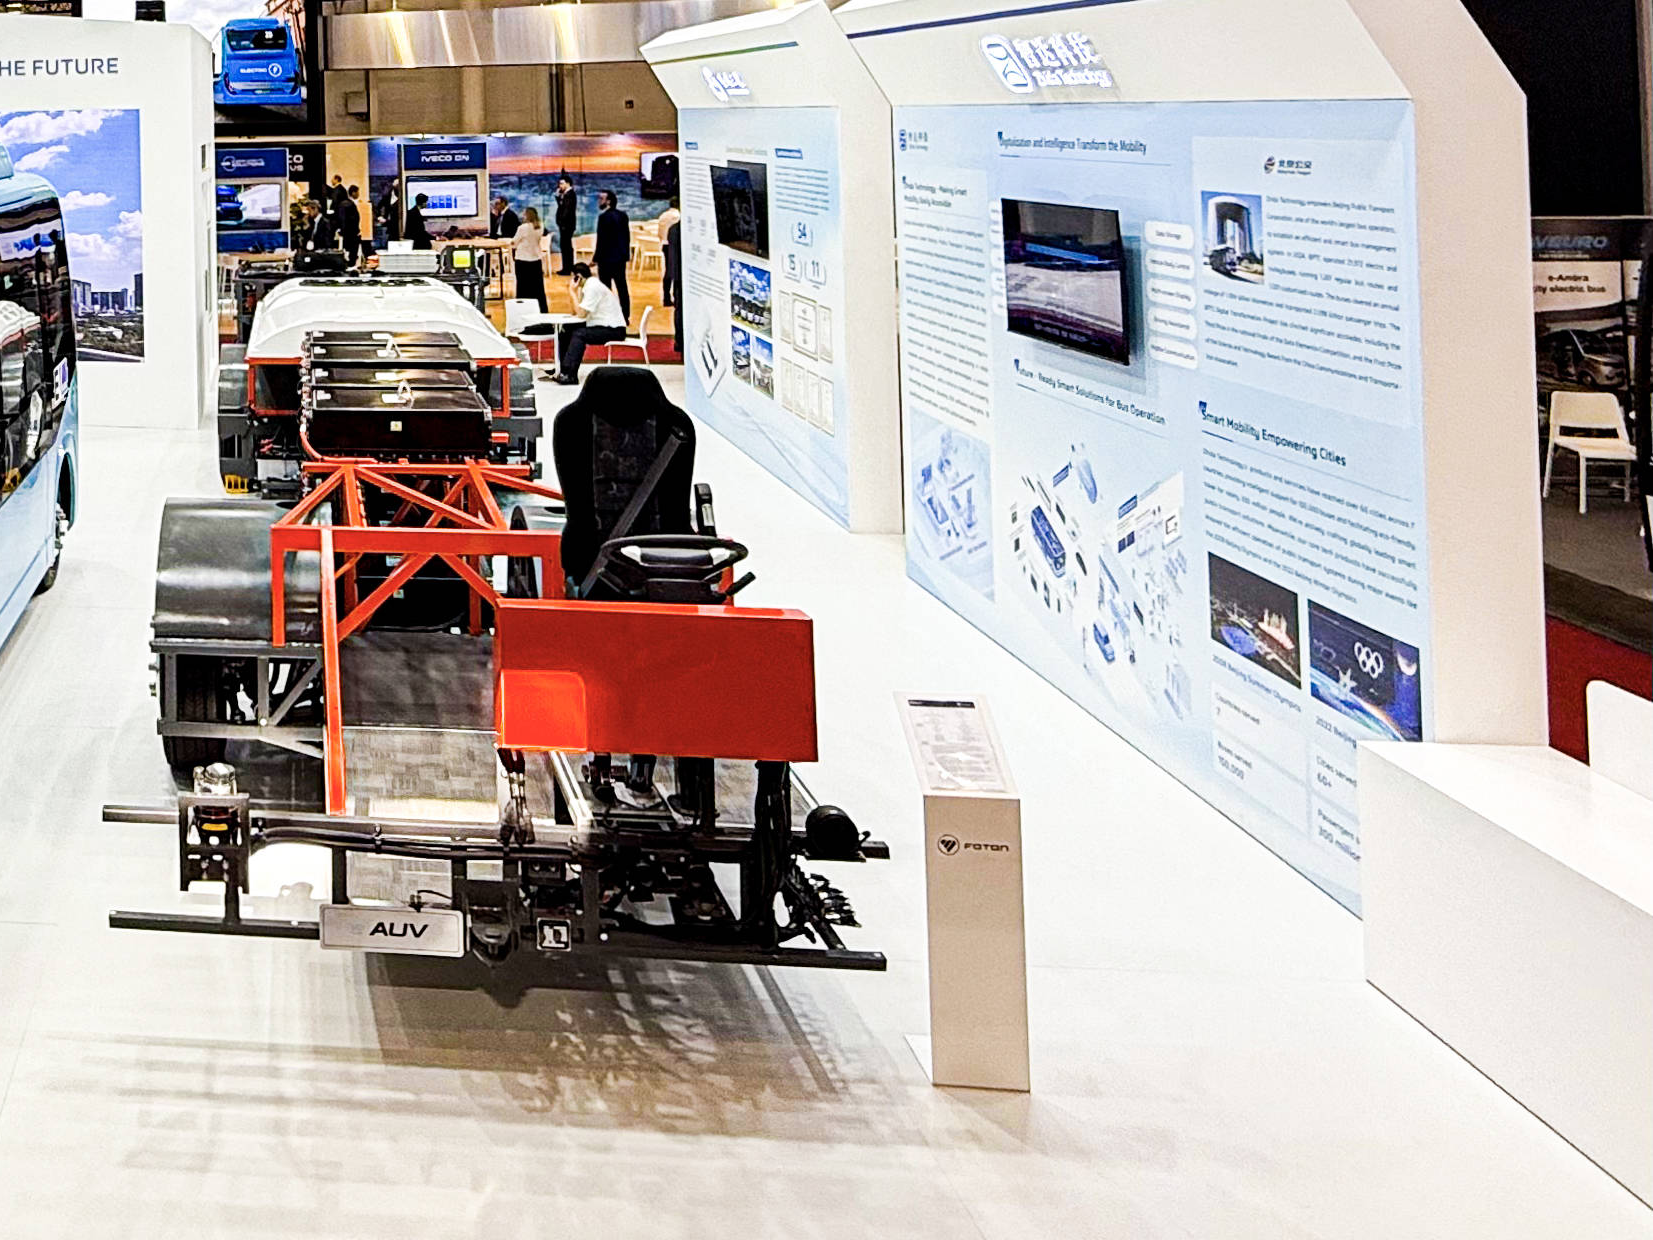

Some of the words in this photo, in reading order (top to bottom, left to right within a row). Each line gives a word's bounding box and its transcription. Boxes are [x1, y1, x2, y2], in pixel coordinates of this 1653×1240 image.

[32, 57, 119, 76] FUTURE
[1549, 285, 1585, 293] electric
[1587, 285, 1606, 293] bus
[1202, 410, 1225, 427] Smart
[1226, 416, 1260, 441] Mobility
[1262, 428, 1317, 460] Empowering
[1320, 447, 1346, 466] Cities
[964, 842, 1009, 852] FOTON
[369, 921, 429, 939] AUV
